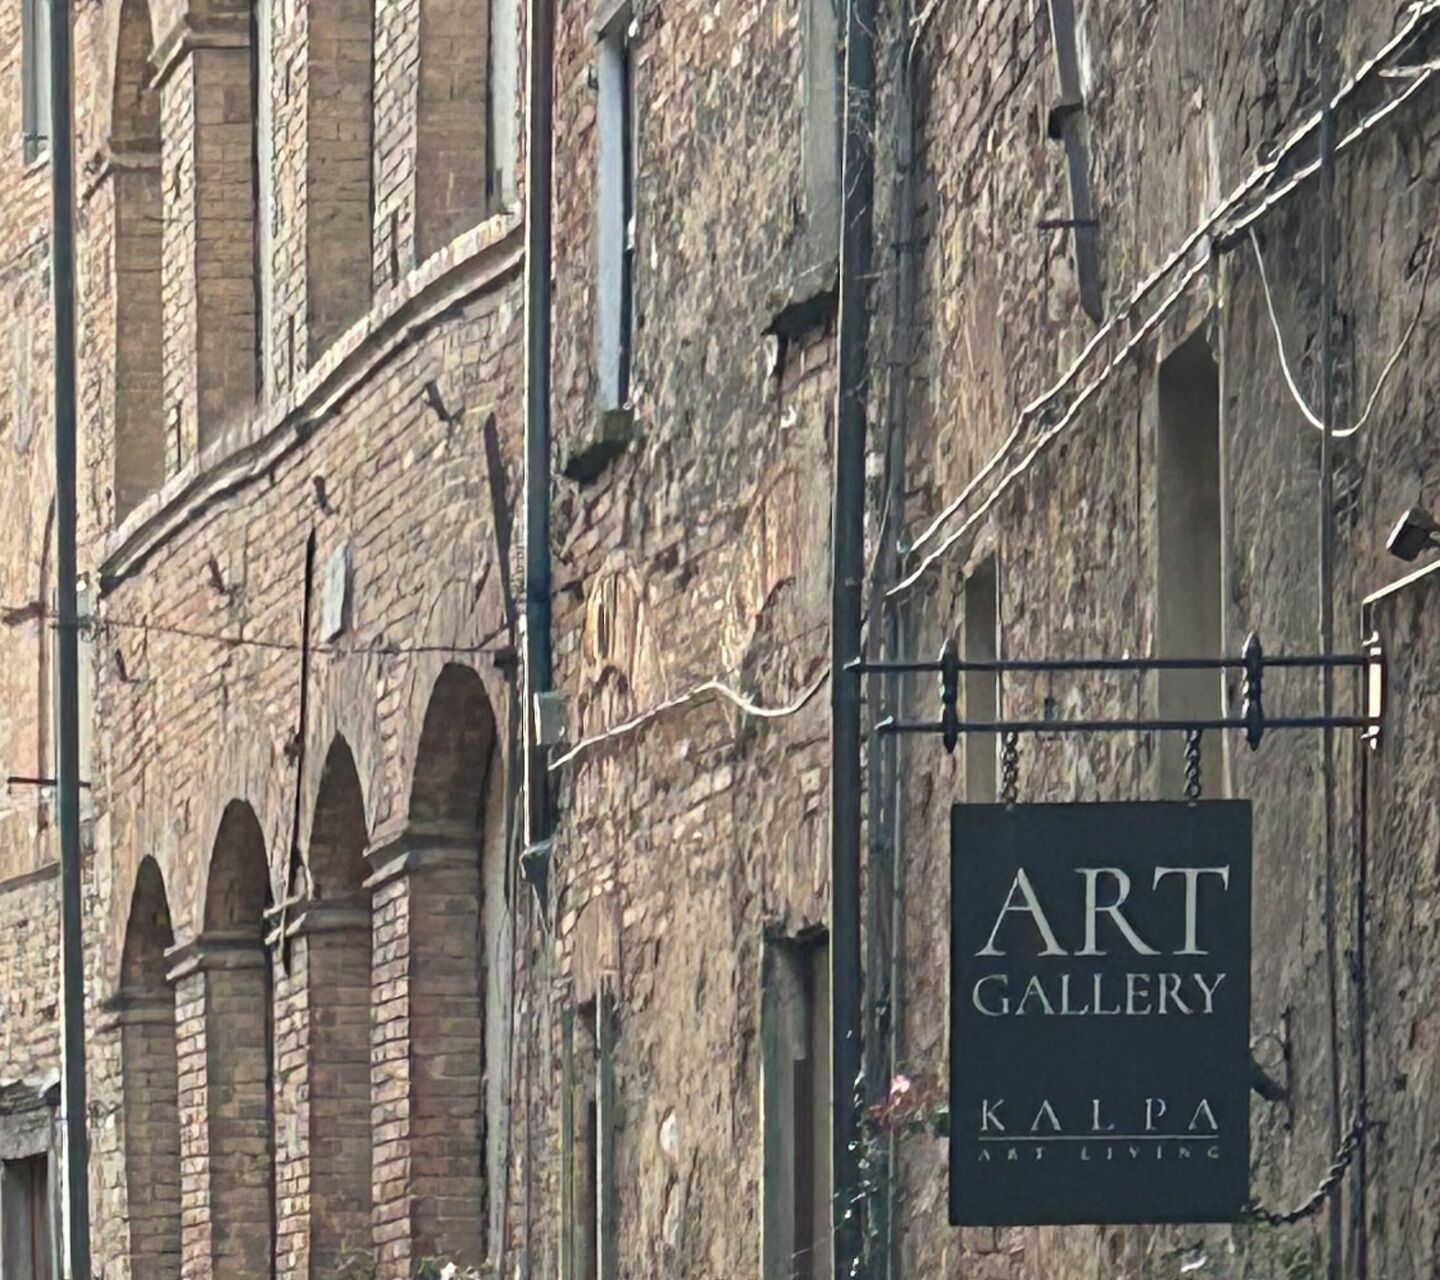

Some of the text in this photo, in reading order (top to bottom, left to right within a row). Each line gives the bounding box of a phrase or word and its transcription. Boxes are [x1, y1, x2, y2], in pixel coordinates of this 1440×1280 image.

[974, 864, 1231, 957] ART
[972, 972, 1227, 1017] GALLERY
[980, 1098, 1219, 1131] KALPA
